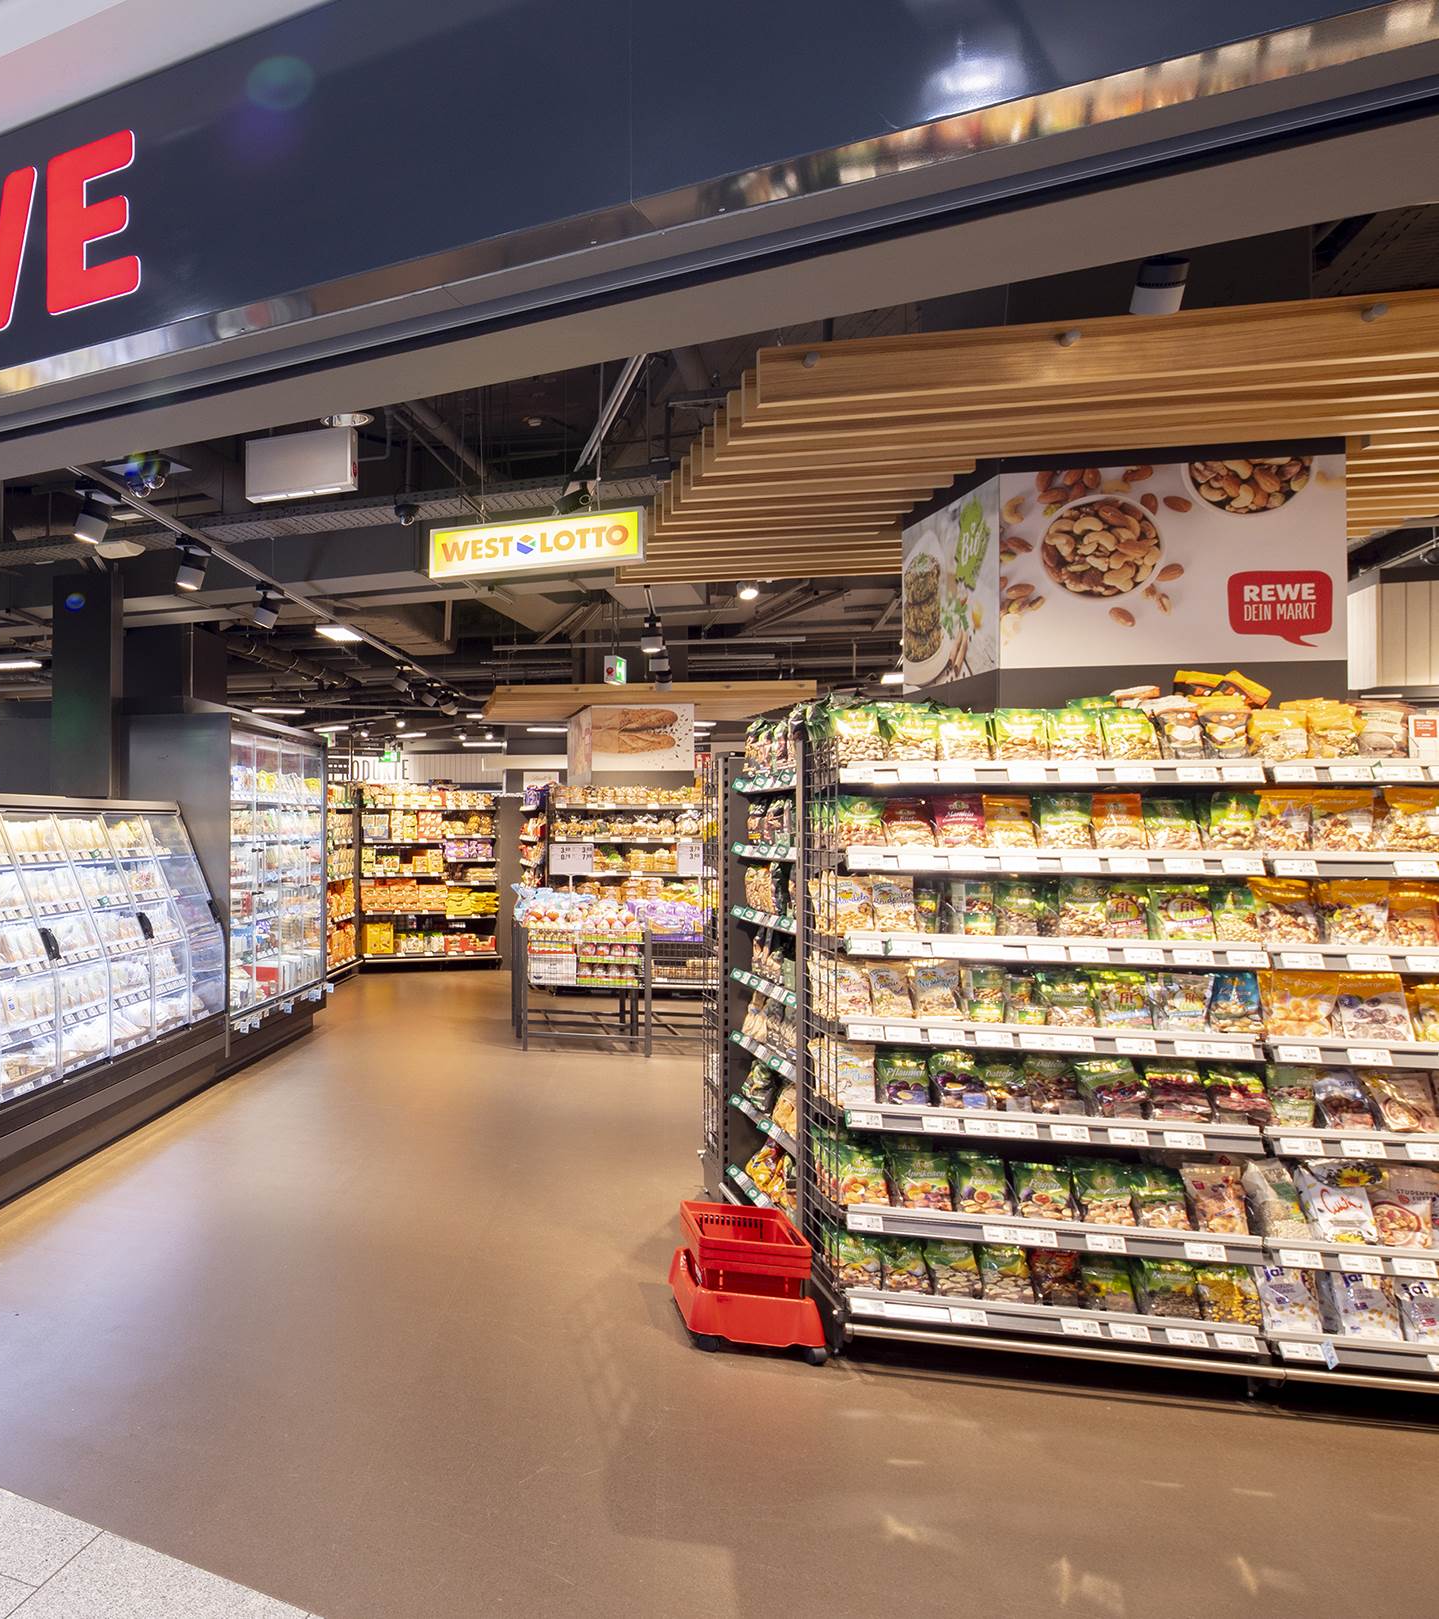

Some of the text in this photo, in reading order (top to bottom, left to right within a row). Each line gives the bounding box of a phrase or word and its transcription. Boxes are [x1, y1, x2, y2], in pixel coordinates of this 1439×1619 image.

[440, 524, 629, 563] WEST LOTTO
[1243, 582, 1317, 603] REWE
[1244, 602, 1317, 622] DEIN MARKT
[1262, 1265, 1284, 1282] ja!
[1341, 1271, 1363, 1288] ja!
[1400, 1281, 1430, 1301] ja!
